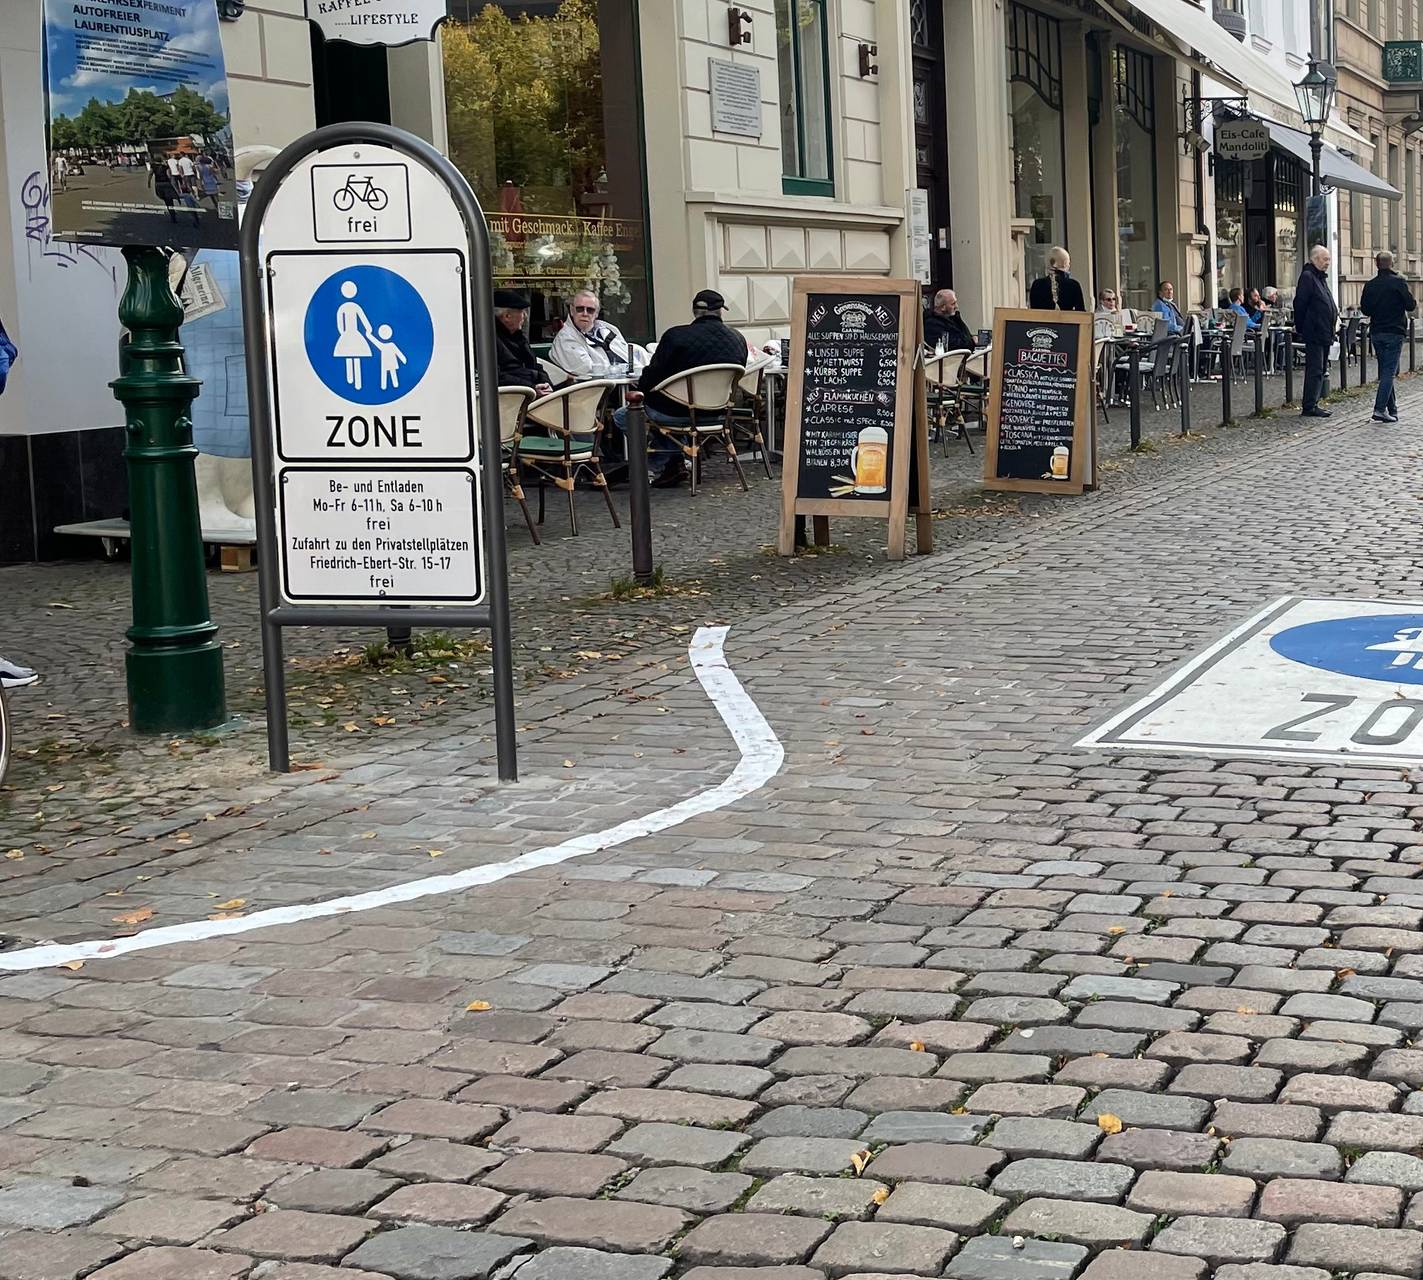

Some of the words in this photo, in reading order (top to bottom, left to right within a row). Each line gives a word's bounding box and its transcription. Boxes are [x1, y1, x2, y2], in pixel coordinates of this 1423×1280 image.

[73, 4, 141, 23] AUTOFREIER
[74, 19, 171, 42] LAURENTIUSPLATZ
[1220, 141, 1268, 152] Mandoliti
[347, 216, 377, 233] frei
[490, 217, 510, 233] mit
[583, 220, 614, 237] Kaffee
[809, 305, 826, 325] NEU
[874, 306, 892, 327] NEU
[814, 348, 839, 358] LINSEN
[843, 348, 864, 357] SUPPE
[840, 368, 863, 377] SUPPE
[823, 376, 848, 385] LACHS
[812, 403, 855, 414] CAPRESE
[810, 415, 842, 425] CLASSIC
[325, 415, 423, 448] ZONE
[329, 479, 348, 493] Be-
[353, 479, 373, 493] und
[377, 479, 424, 493] Entladen
[313, 498, 346, 513] Mo-Fr
[390, 498, 404, 513] Sa
[366, 517, 391, 530] frei
[292, 537, 331, 551] Zufahrt
[335, 541, 347, 551] zu
[352, 537, 371, 551] den
[376, 537, 469, 554] Privatstellplätzen
[310, 556, 417, 570] Friedrich-Ebert-Str.
[421, 556, 451, 570] 15-17
[369, 575, 394, 588] frei
